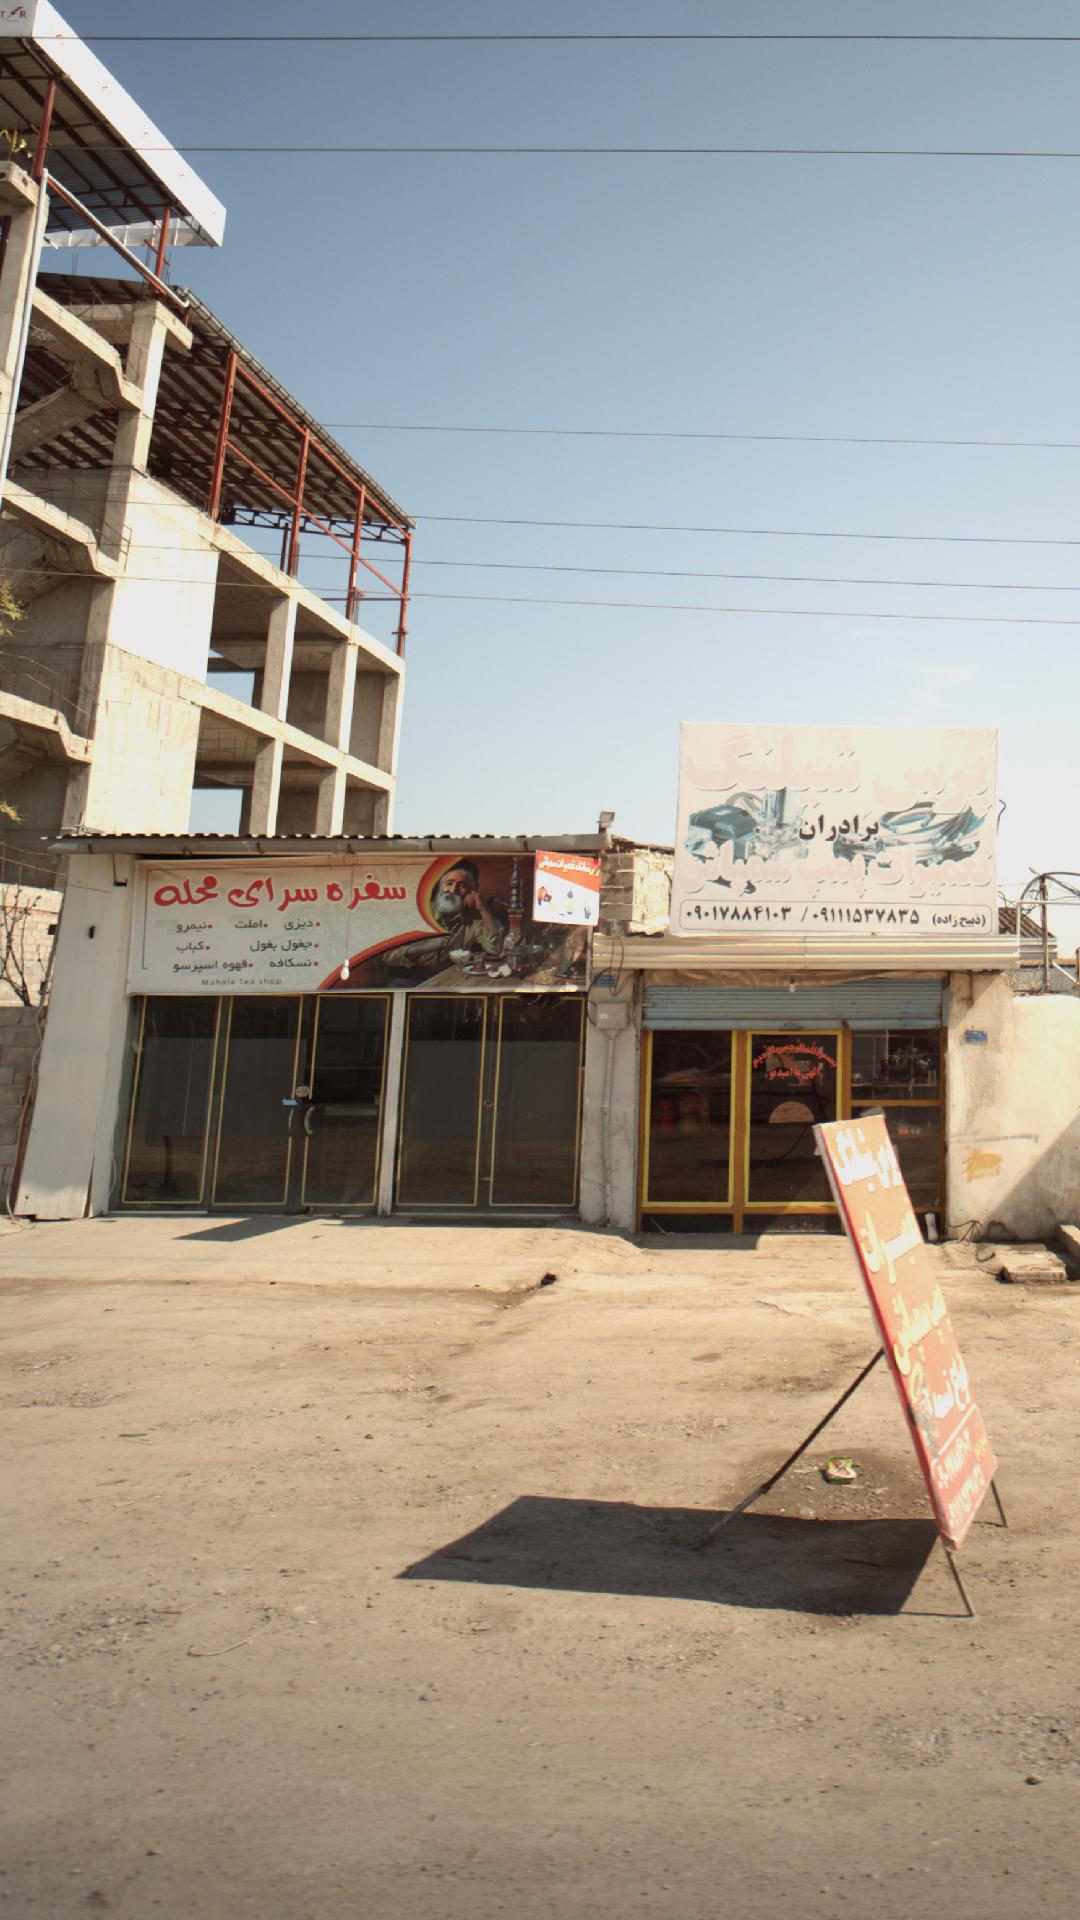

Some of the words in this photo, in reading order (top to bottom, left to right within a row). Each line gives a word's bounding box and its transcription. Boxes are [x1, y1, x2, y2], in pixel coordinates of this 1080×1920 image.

[799, 813, 880, 842] برادران
[153, 874, 219, 906] محله
[227, 876, 319, 912] سرای
[326, 873, 408, 910] سفره
[686, 905, 792, 921] ۰۹۰۱۷۸۸۴۱۰۳
[812, 907, 921, 925] ۰۹۱۱۱۵۳۷۸۳۵
[176, 922, 207, 934] نیمرو
[234, 919, 263, 929] املت
[284, 919, 313, 931] دیزی
[176, 940, 205, 952] کباب
[222, 959, 248, 972] قهوه
[269, 957, 312, 968] نسکافه
[258, 977, 282, 986] shop
